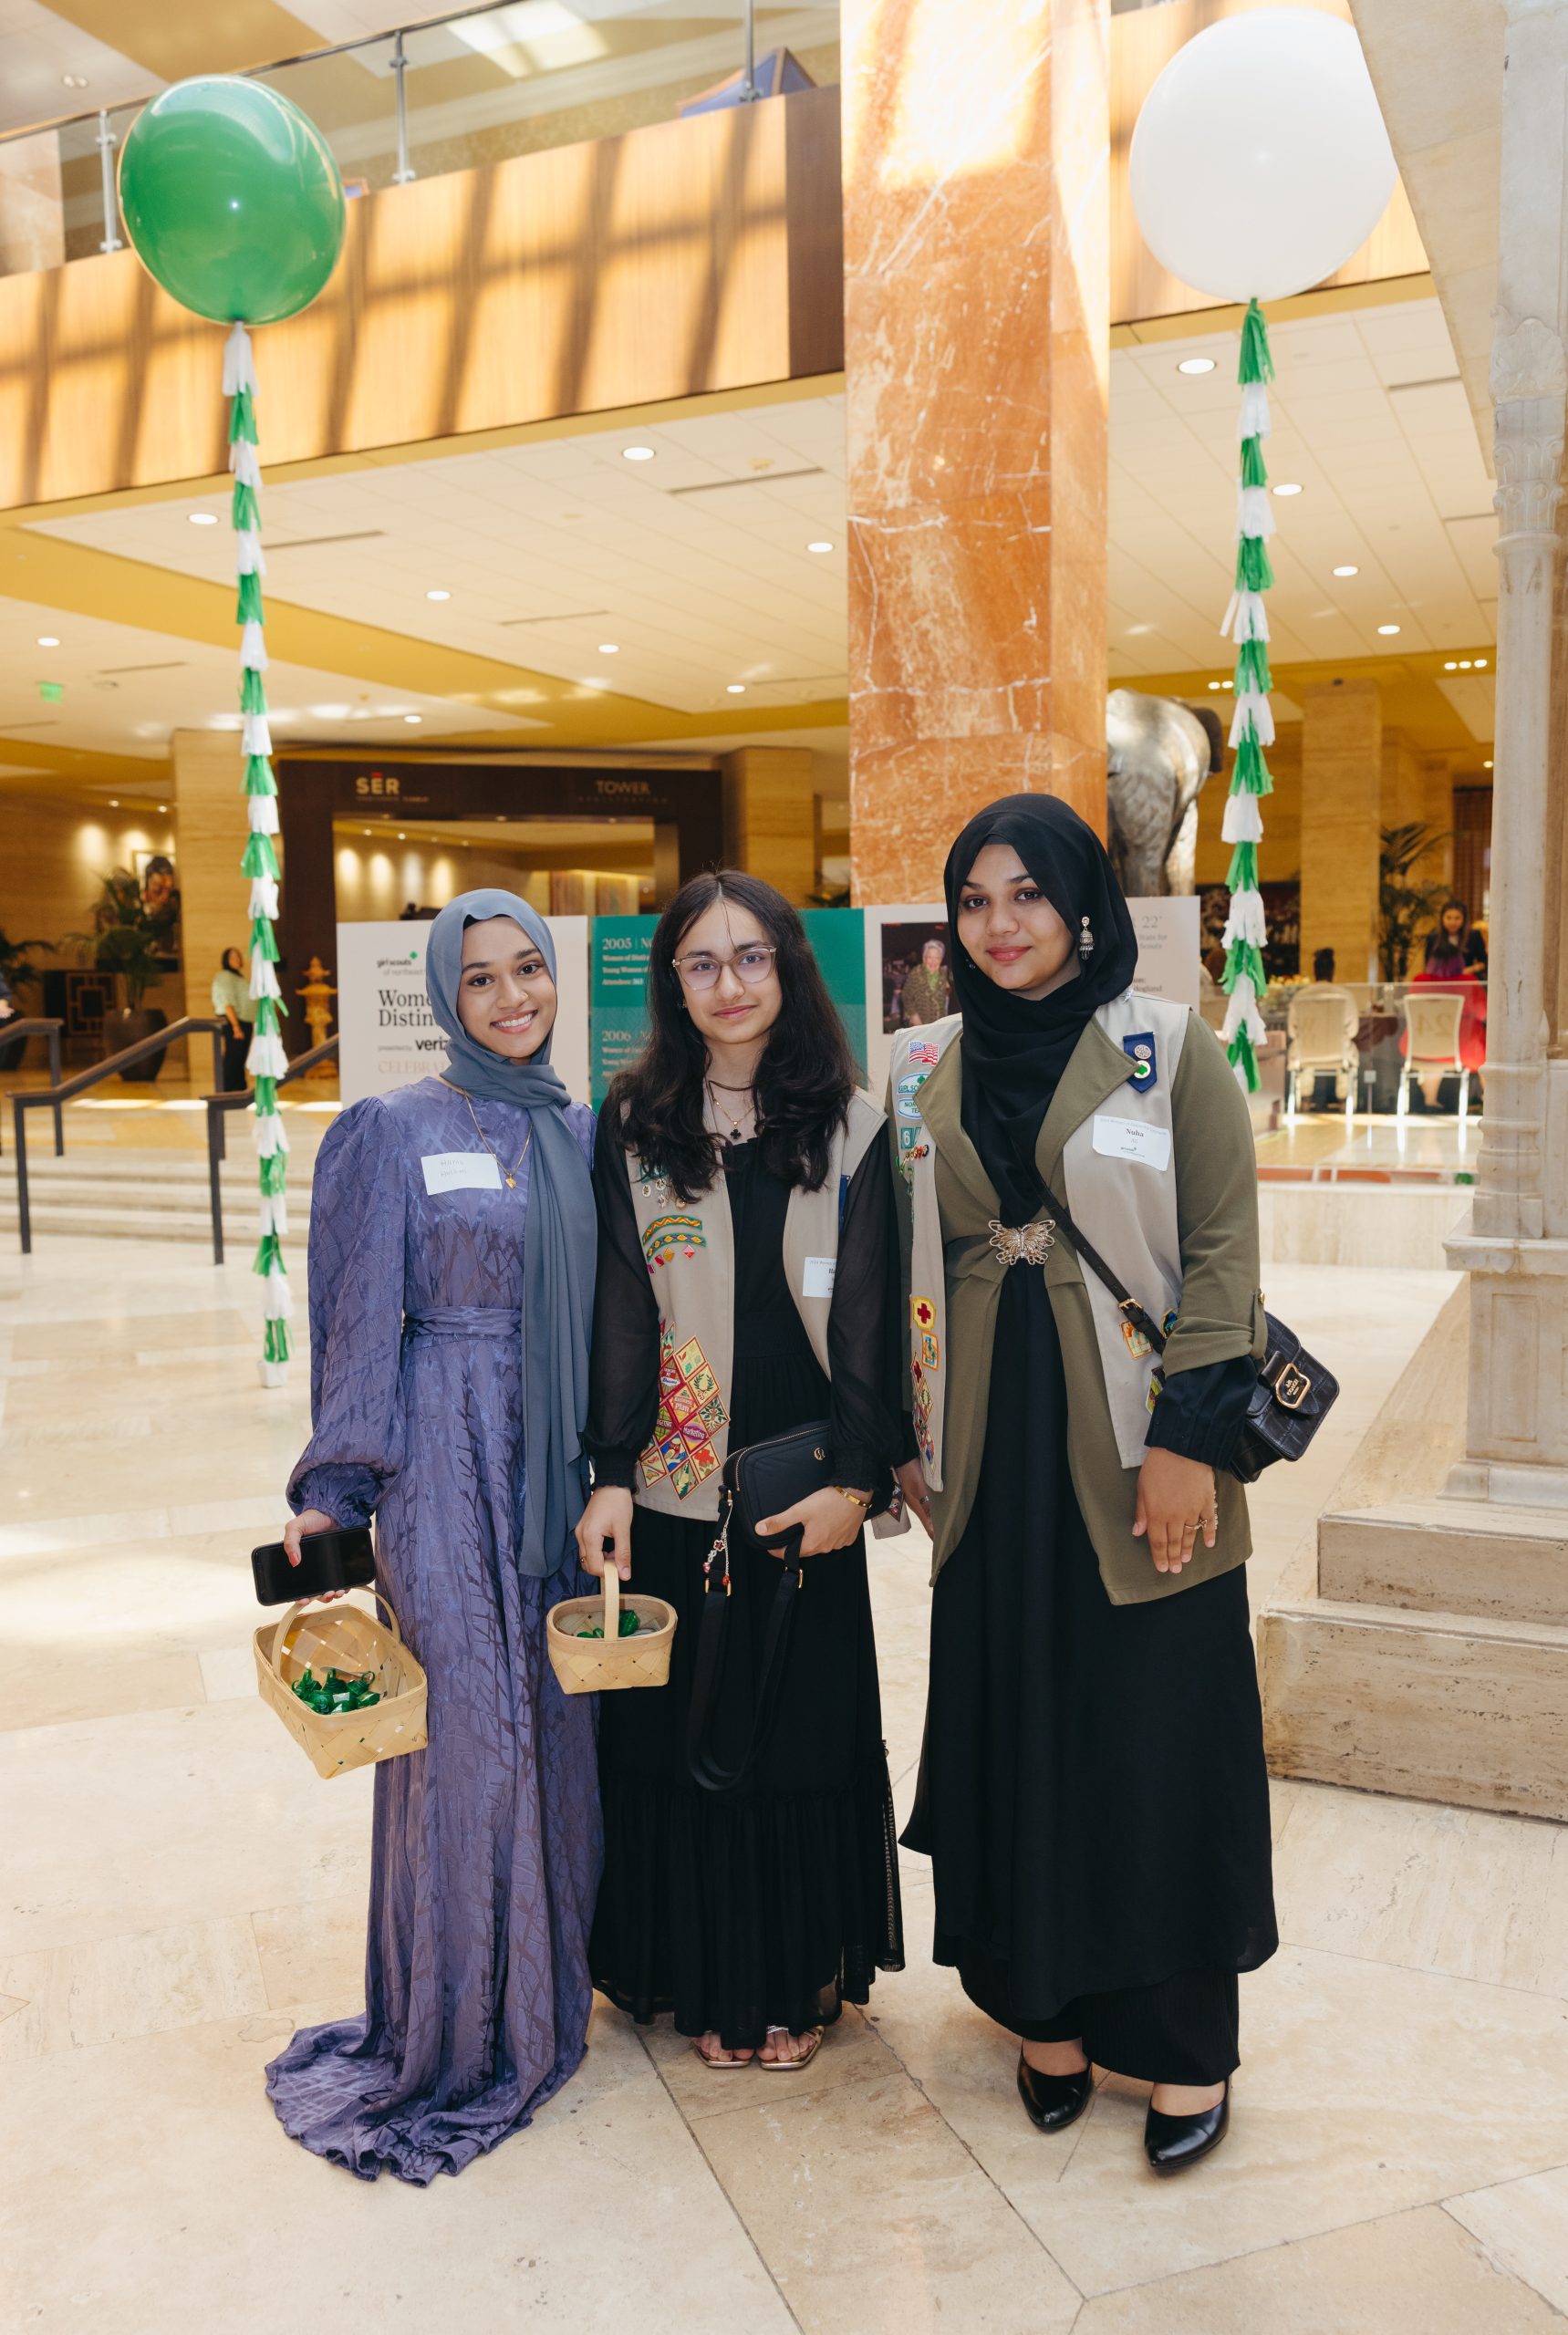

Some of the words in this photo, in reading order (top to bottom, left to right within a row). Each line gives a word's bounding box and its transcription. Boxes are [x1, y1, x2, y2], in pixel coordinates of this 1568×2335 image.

[602, 938, 632, 950] 2005
[602, 1030, 632, 1042] 2006
[1126, 1127, 1144, 1138] Nuha
[683, 1427, 705, 1439] Marketing
